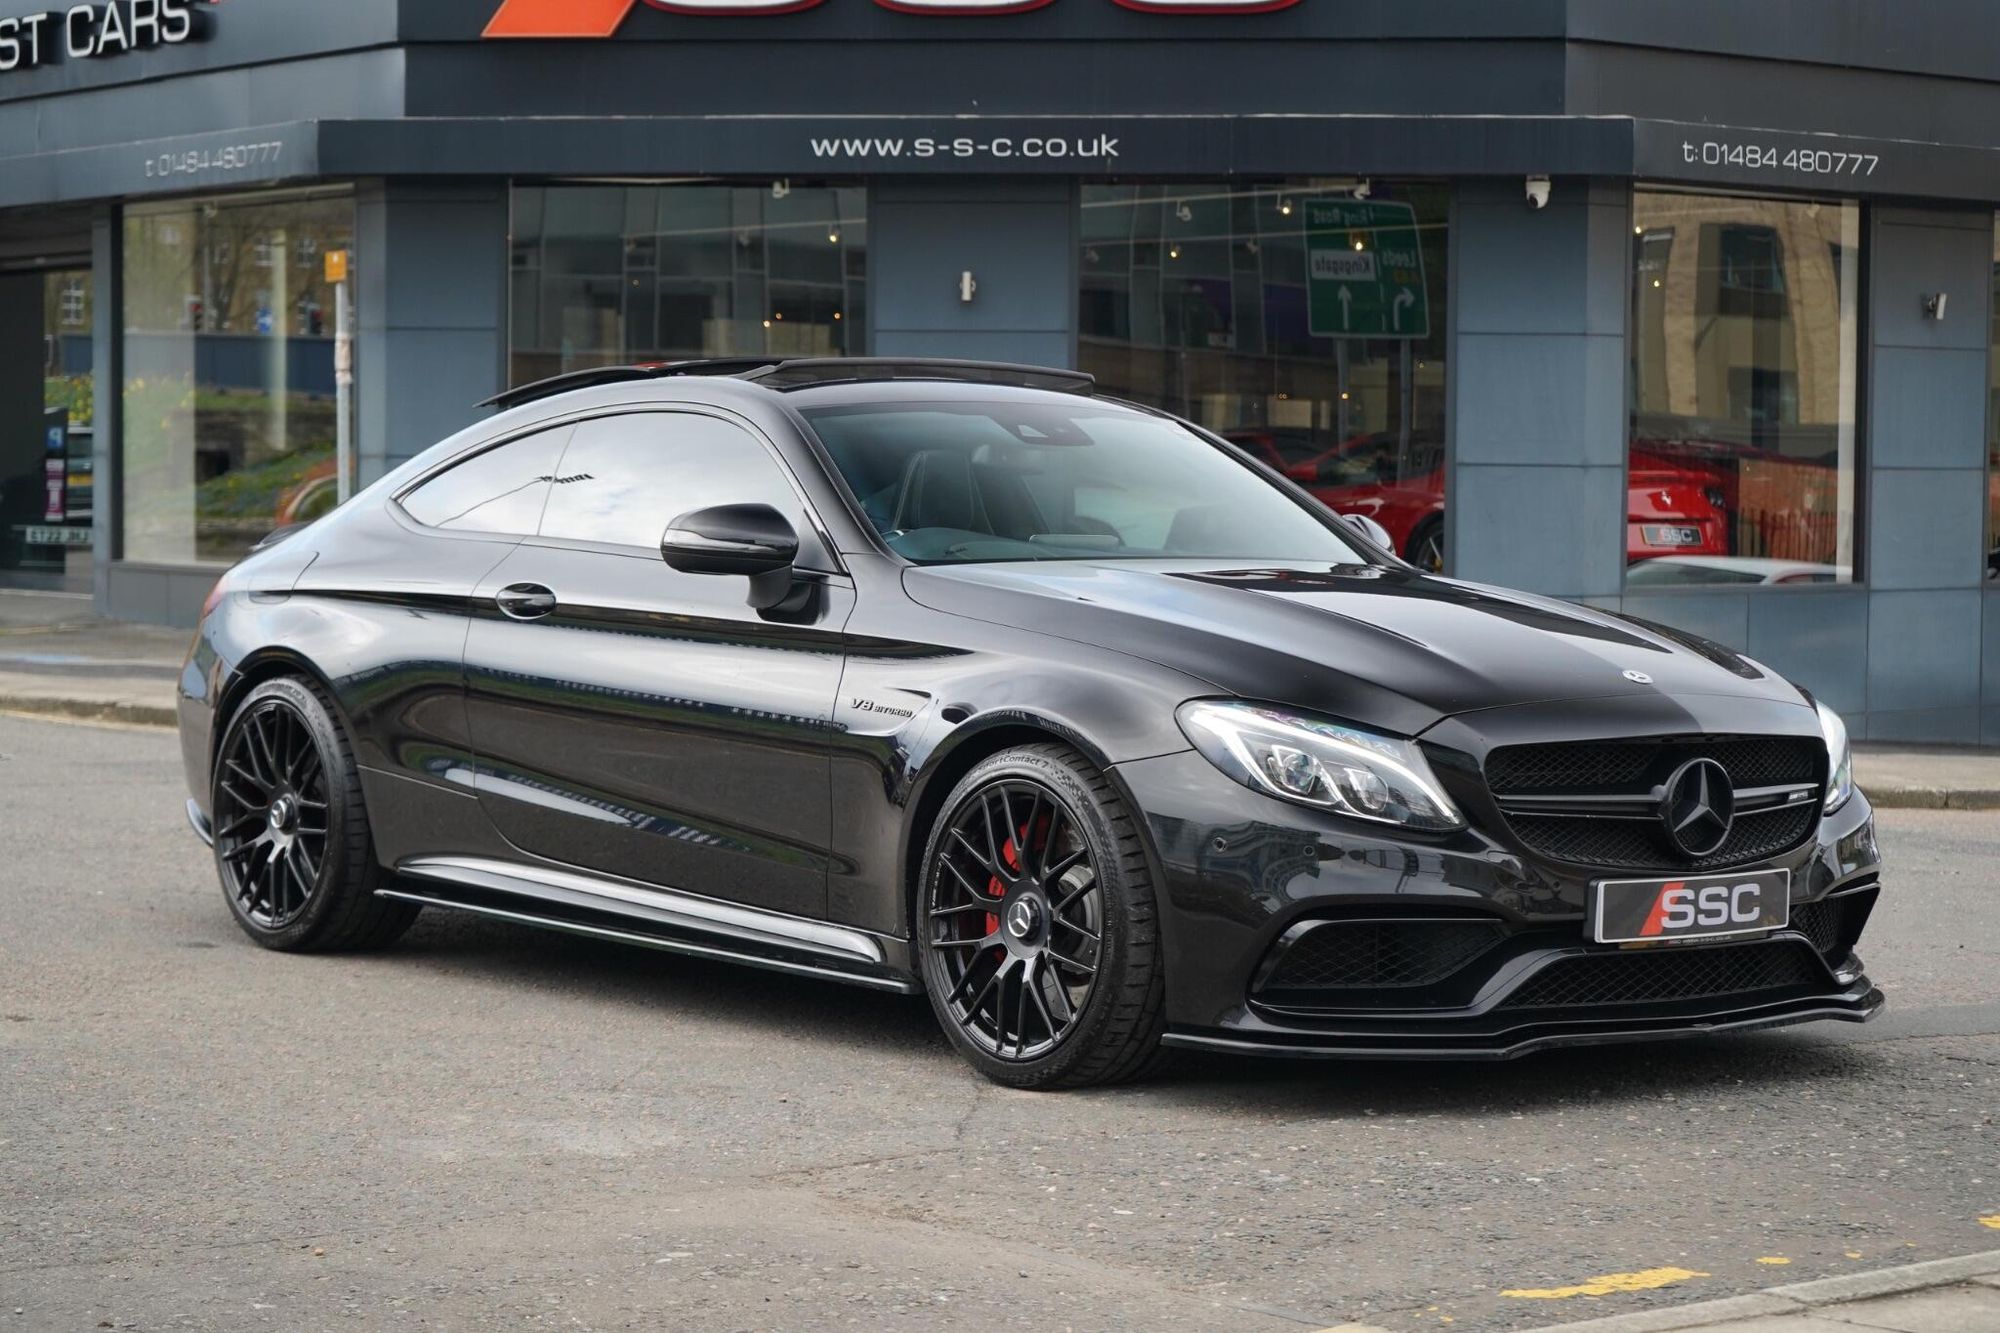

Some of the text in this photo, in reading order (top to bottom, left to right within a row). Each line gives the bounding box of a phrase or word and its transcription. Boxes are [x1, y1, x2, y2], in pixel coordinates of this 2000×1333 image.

[0, 0, 190, 70] ST CARS
[810, 134, 1119, 157] www.s-s-c.co.uk
[1782, 149, 1879, 176] 480777
[1661, 528, 1692, 542] SSC
[851, 698, 914, 718] V8 BITURBO
[977, 754, 1041, 772] ortContact
[1661, 883, 1760, 929] SSC
